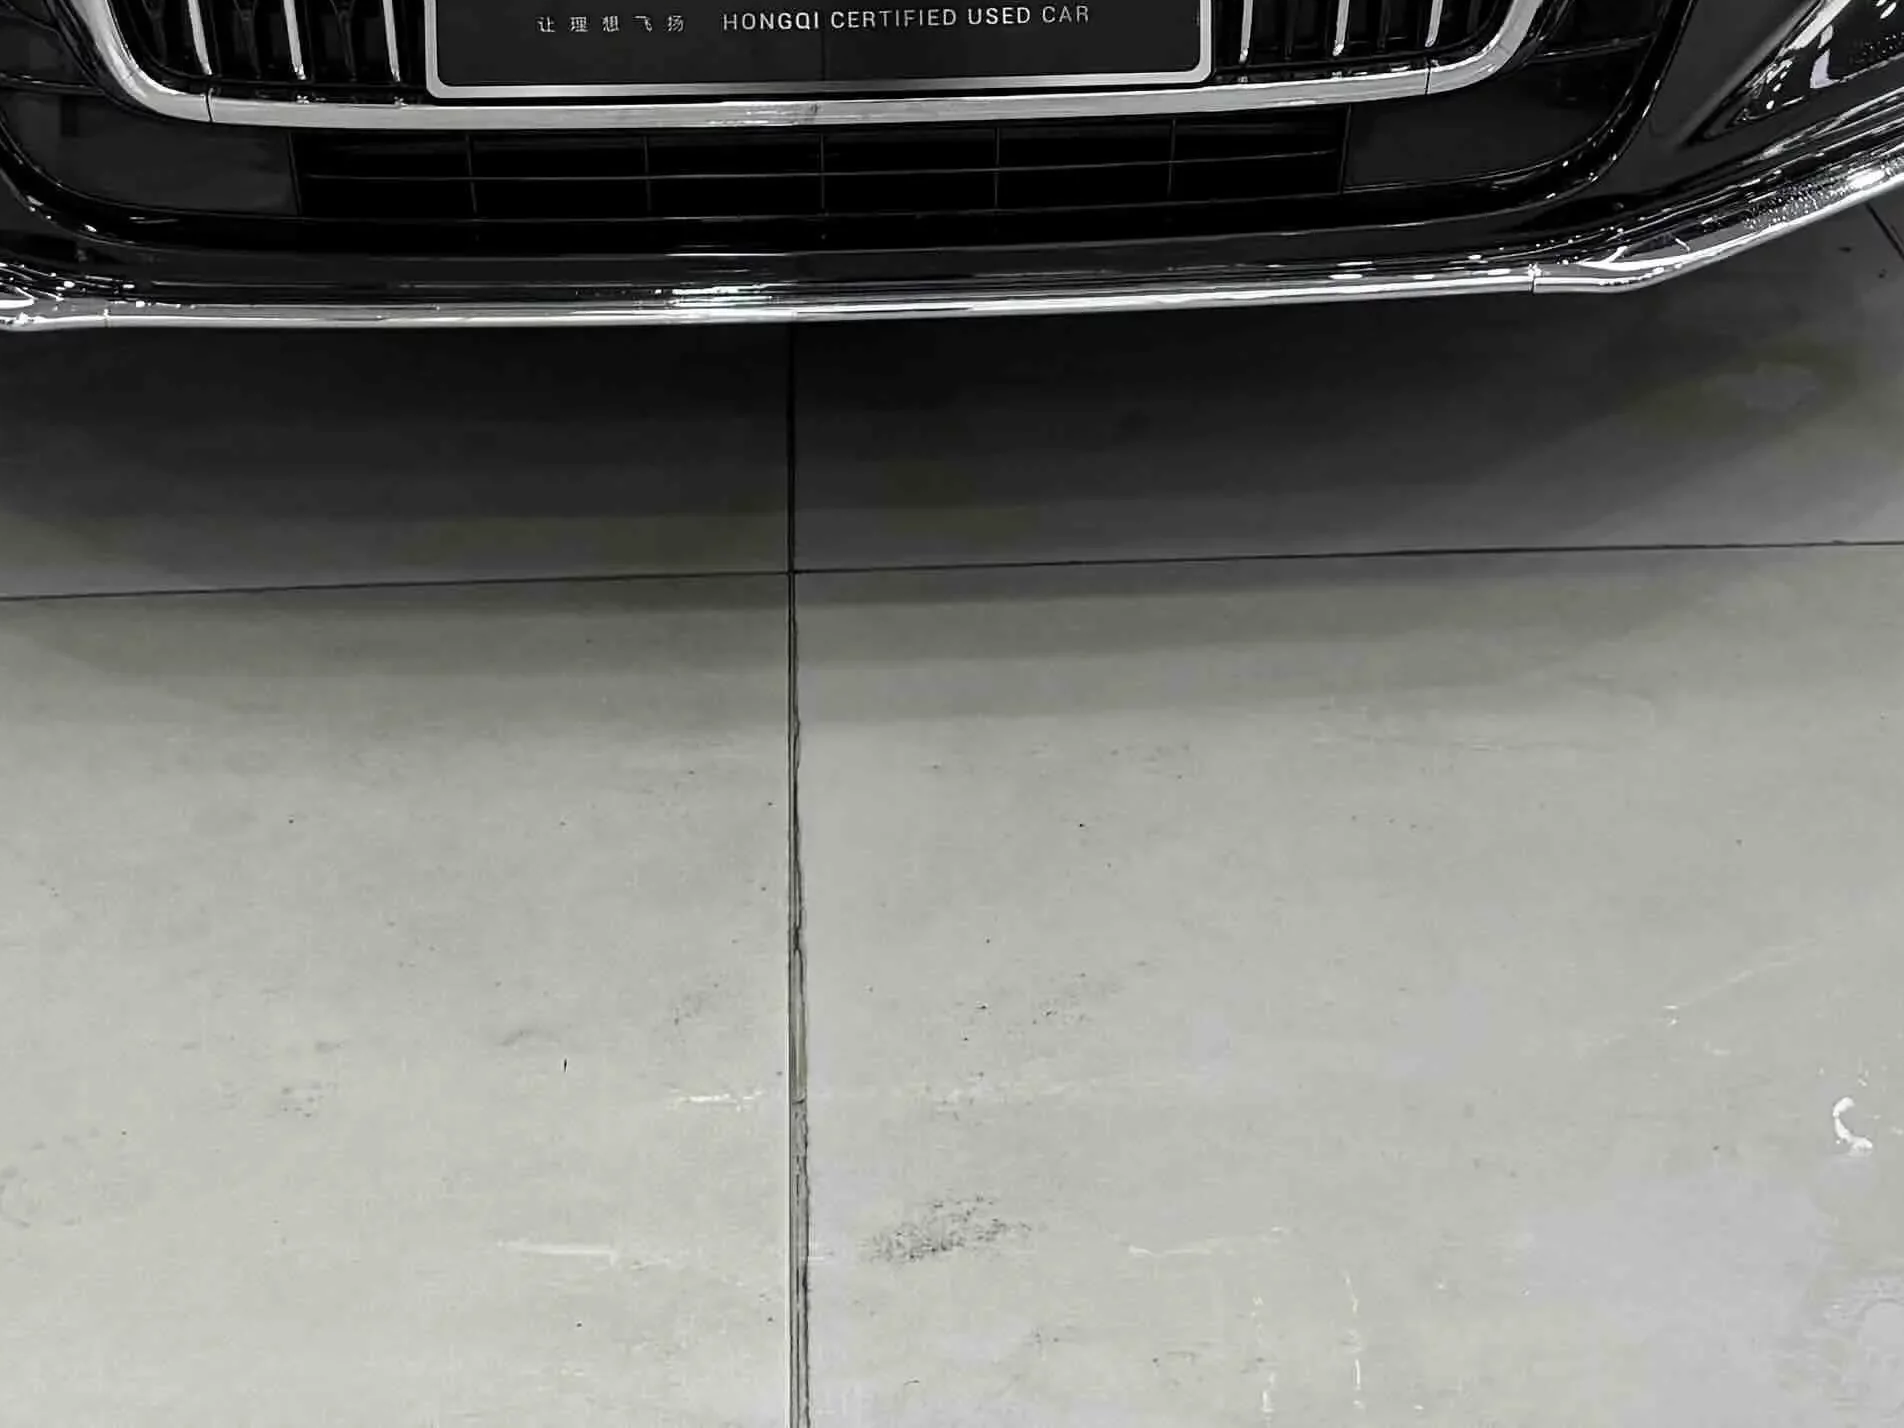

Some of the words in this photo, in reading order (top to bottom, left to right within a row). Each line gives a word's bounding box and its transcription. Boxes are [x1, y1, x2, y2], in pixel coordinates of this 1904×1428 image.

[536, 14, 686, 33] 让理想飞扬
[722, 10, 820, 32] HONGQI
[830, 8, 958, 30] CERTIFIED
[967, 6, 1033, 27] USED
[1041, 5, 1091, 25] CAR
